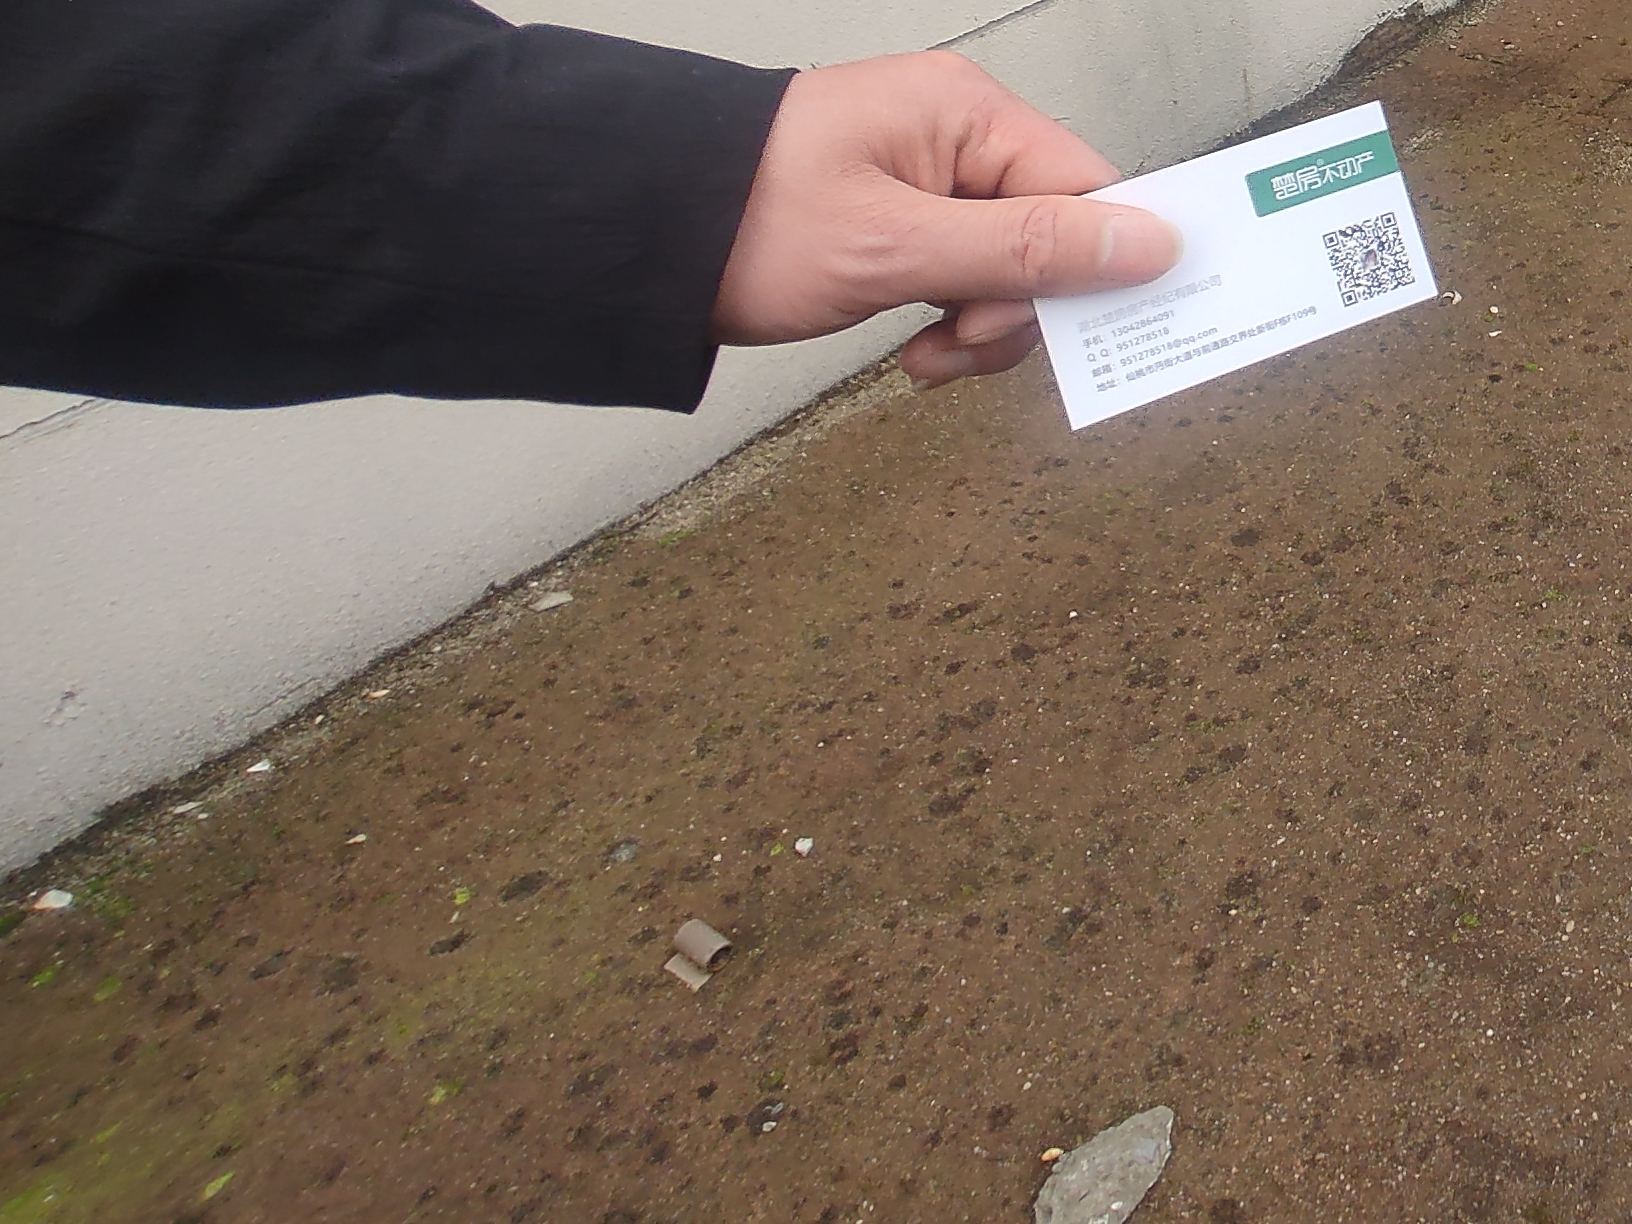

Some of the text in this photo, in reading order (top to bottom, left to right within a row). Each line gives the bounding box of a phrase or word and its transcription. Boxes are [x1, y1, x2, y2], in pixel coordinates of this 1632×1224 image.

[1270, 150, 1375, 200] 楚房不动产
